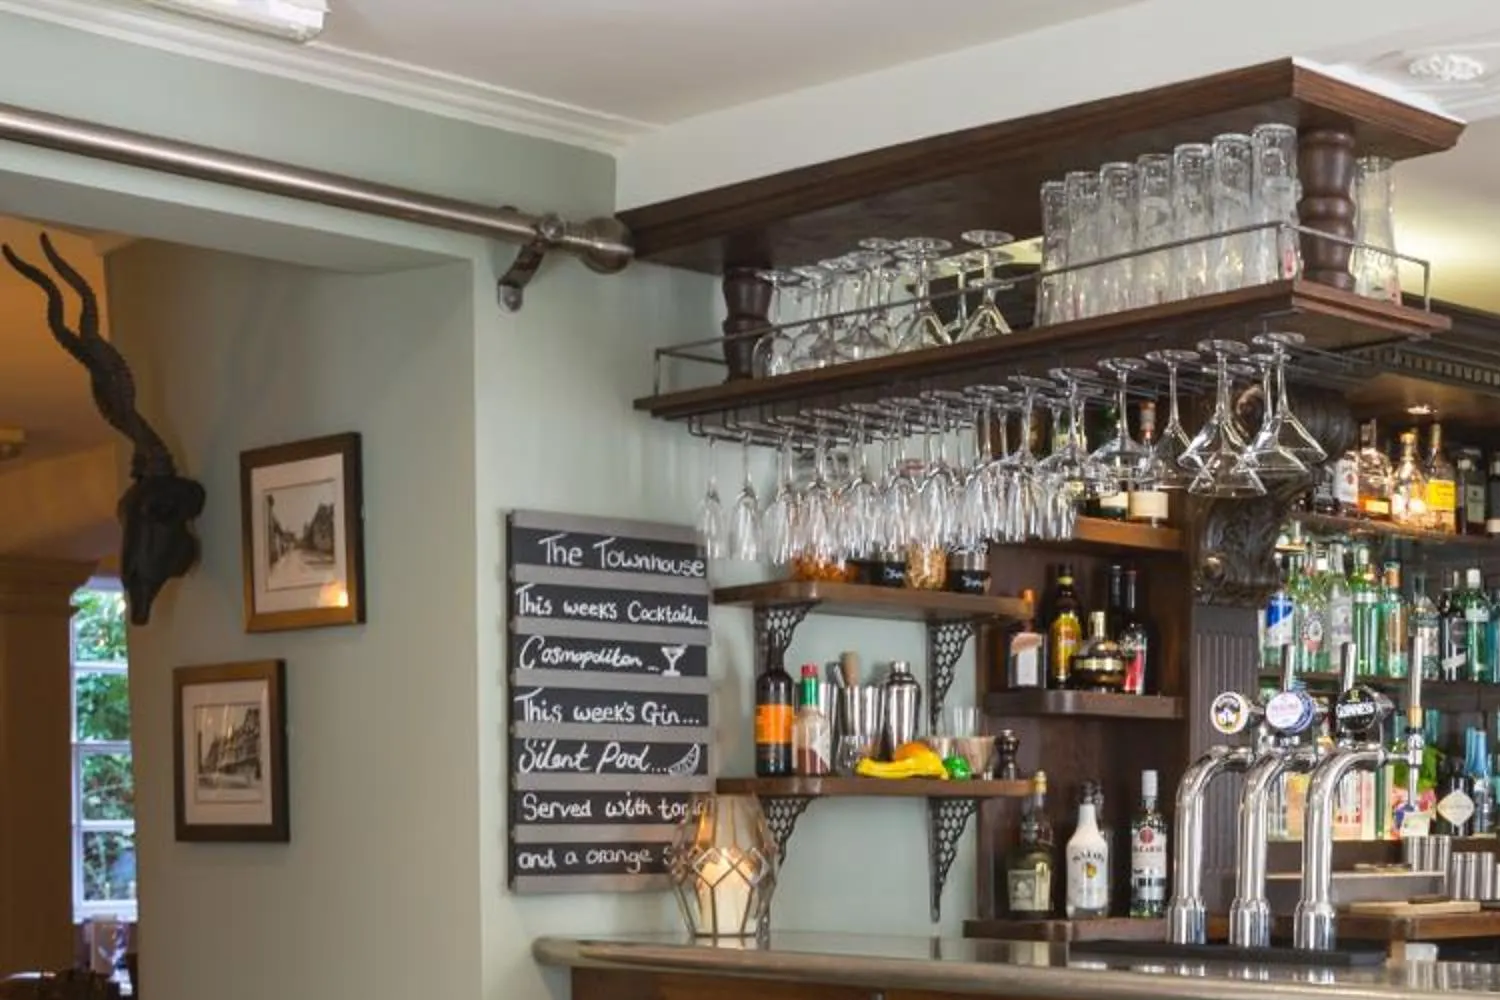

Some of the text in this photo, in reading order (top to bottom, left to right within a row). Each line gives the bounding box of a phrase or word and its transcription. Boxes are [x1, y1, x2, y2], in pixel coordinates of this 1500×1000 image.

[538, 532, 705, 577] The Townhouse
[515, 583, 552, 615] This
[514, 687, 562, 723] This
[573, 701, 635, 723] week's
[519, 739, 592, 773] Silent
[523, 793, 592, 820] Served
[605, 791, 652, 820] with
[519, 848, 556, 869] and
[565, 851, 579, 865] a
[586, 848, 652, 874] orange
